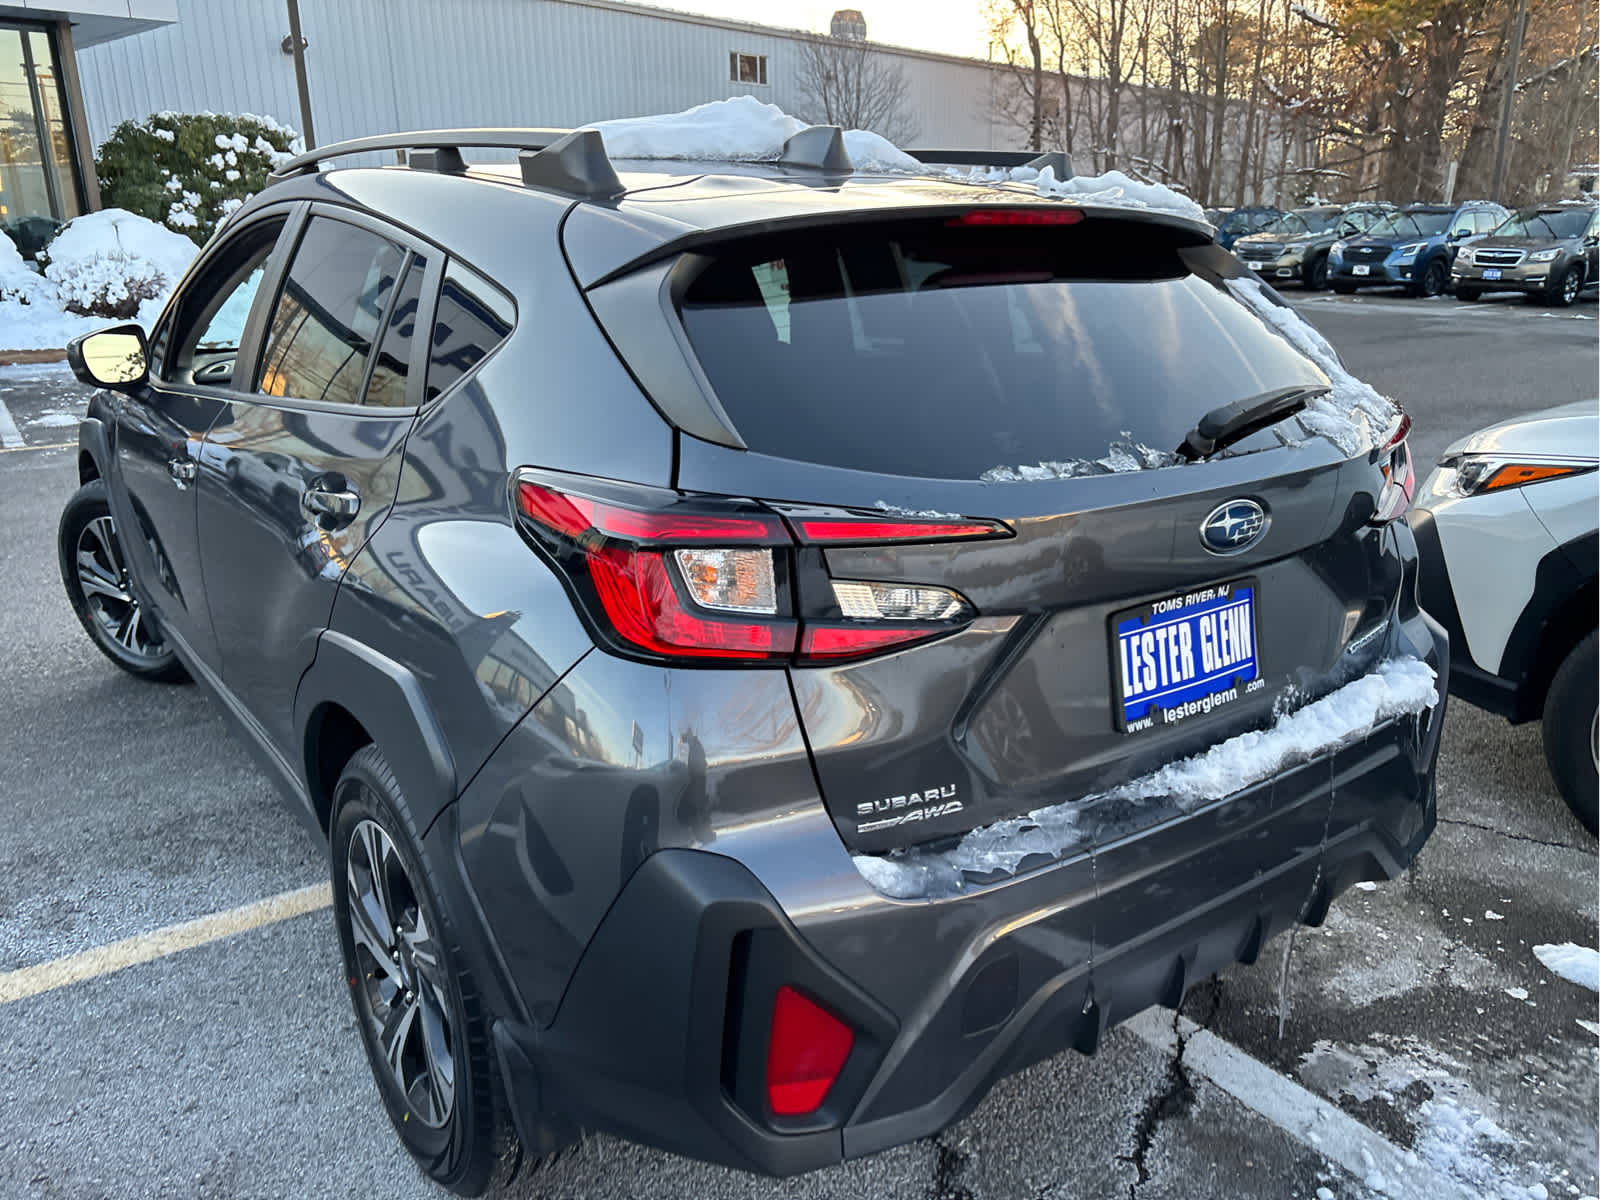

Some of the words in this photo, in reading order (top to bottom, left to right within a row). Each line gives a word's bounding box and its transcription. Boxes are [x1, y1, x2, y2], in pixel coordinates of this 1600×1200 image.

[1151, 598, 1183, 615] TOMS
[1185, 588, 1216, 608] RIVER,
[1217, 584, 1230, 597] NJ
[1119, 621, 1195, 698] LESTER
[1199, 603, 1252, 674] GLENN
[1162, 688, 1237, 723] lesterglenn
[857, 783, 956, 815] SUBARU
[899, 800, 964, 825] AWD
